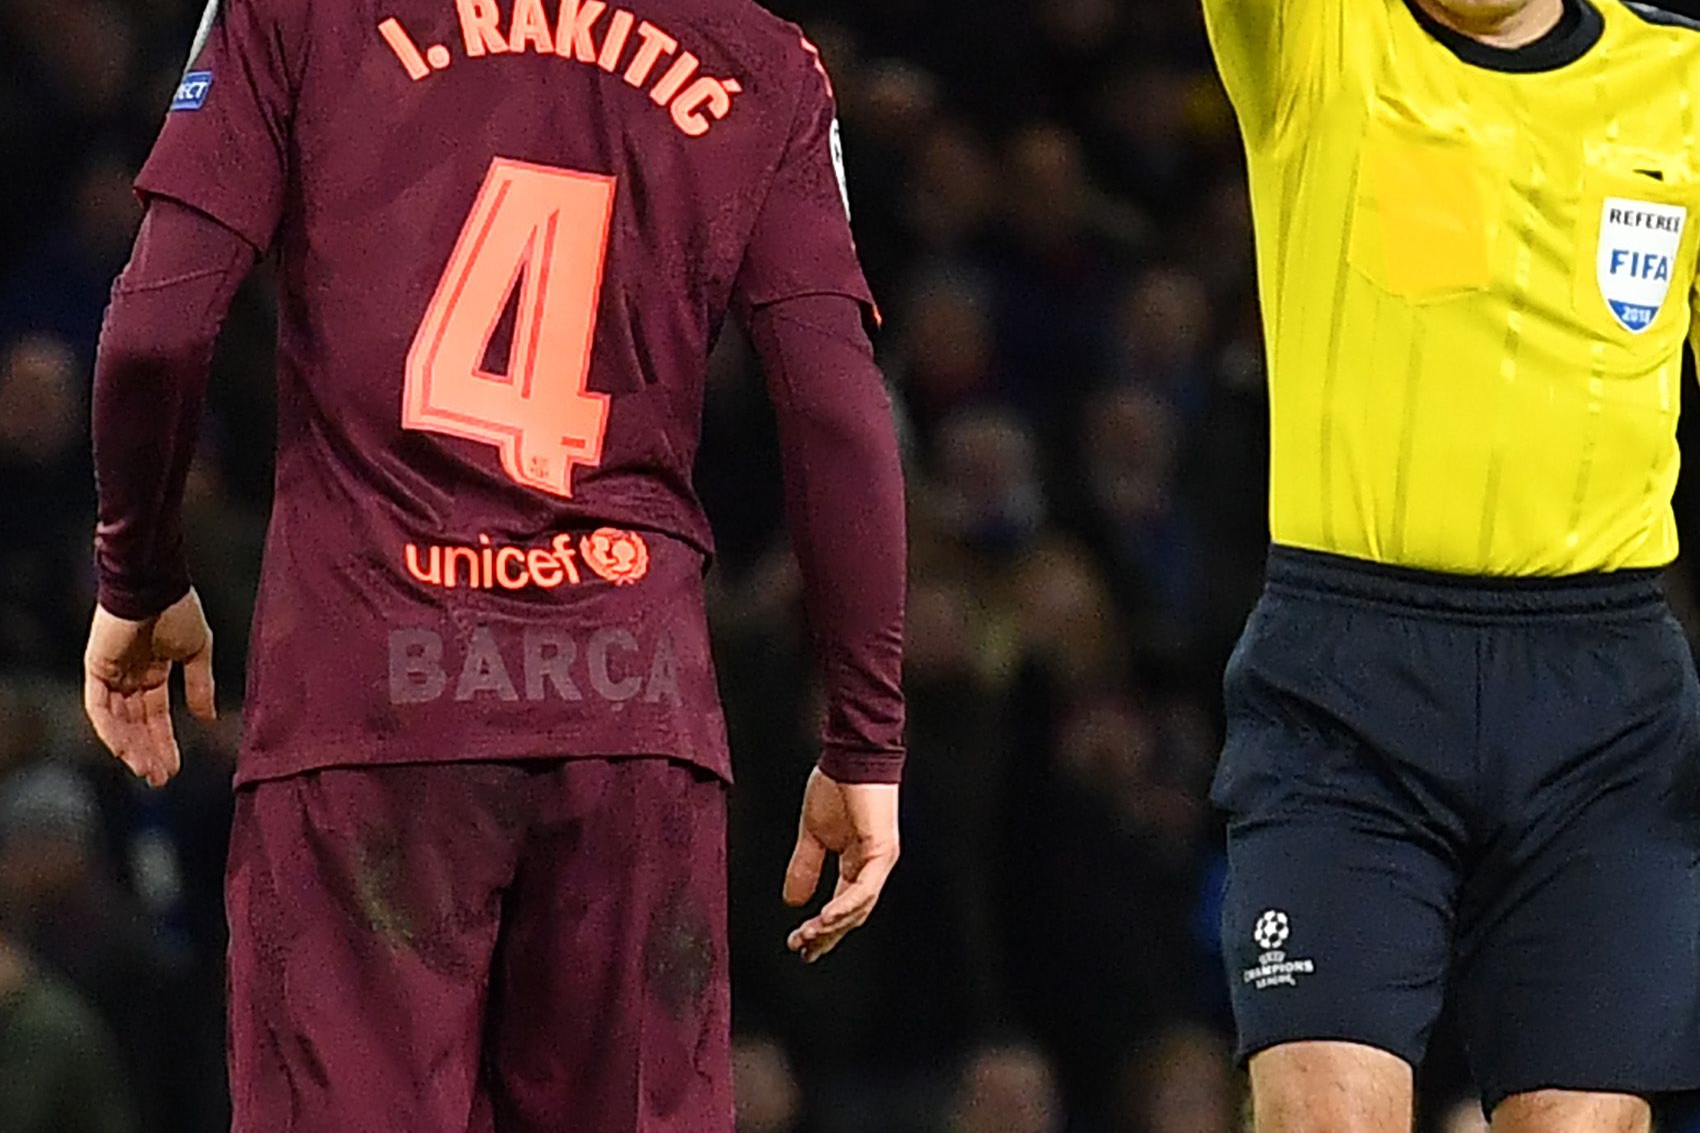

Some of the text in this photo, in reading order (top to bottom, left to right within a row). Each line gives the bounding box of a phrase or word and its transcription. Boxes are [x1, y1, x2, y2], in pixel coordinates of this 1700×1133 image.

[378, 17, 451, 81] I.
[1609, 208, 1681, 233] REFEREE
[1609, 248, 1668, 281] FIFA
[402, 156, 617, 498] 4
[405, 533, 579, 590] unicef
[388, 626, 683, 713] BARÇA
